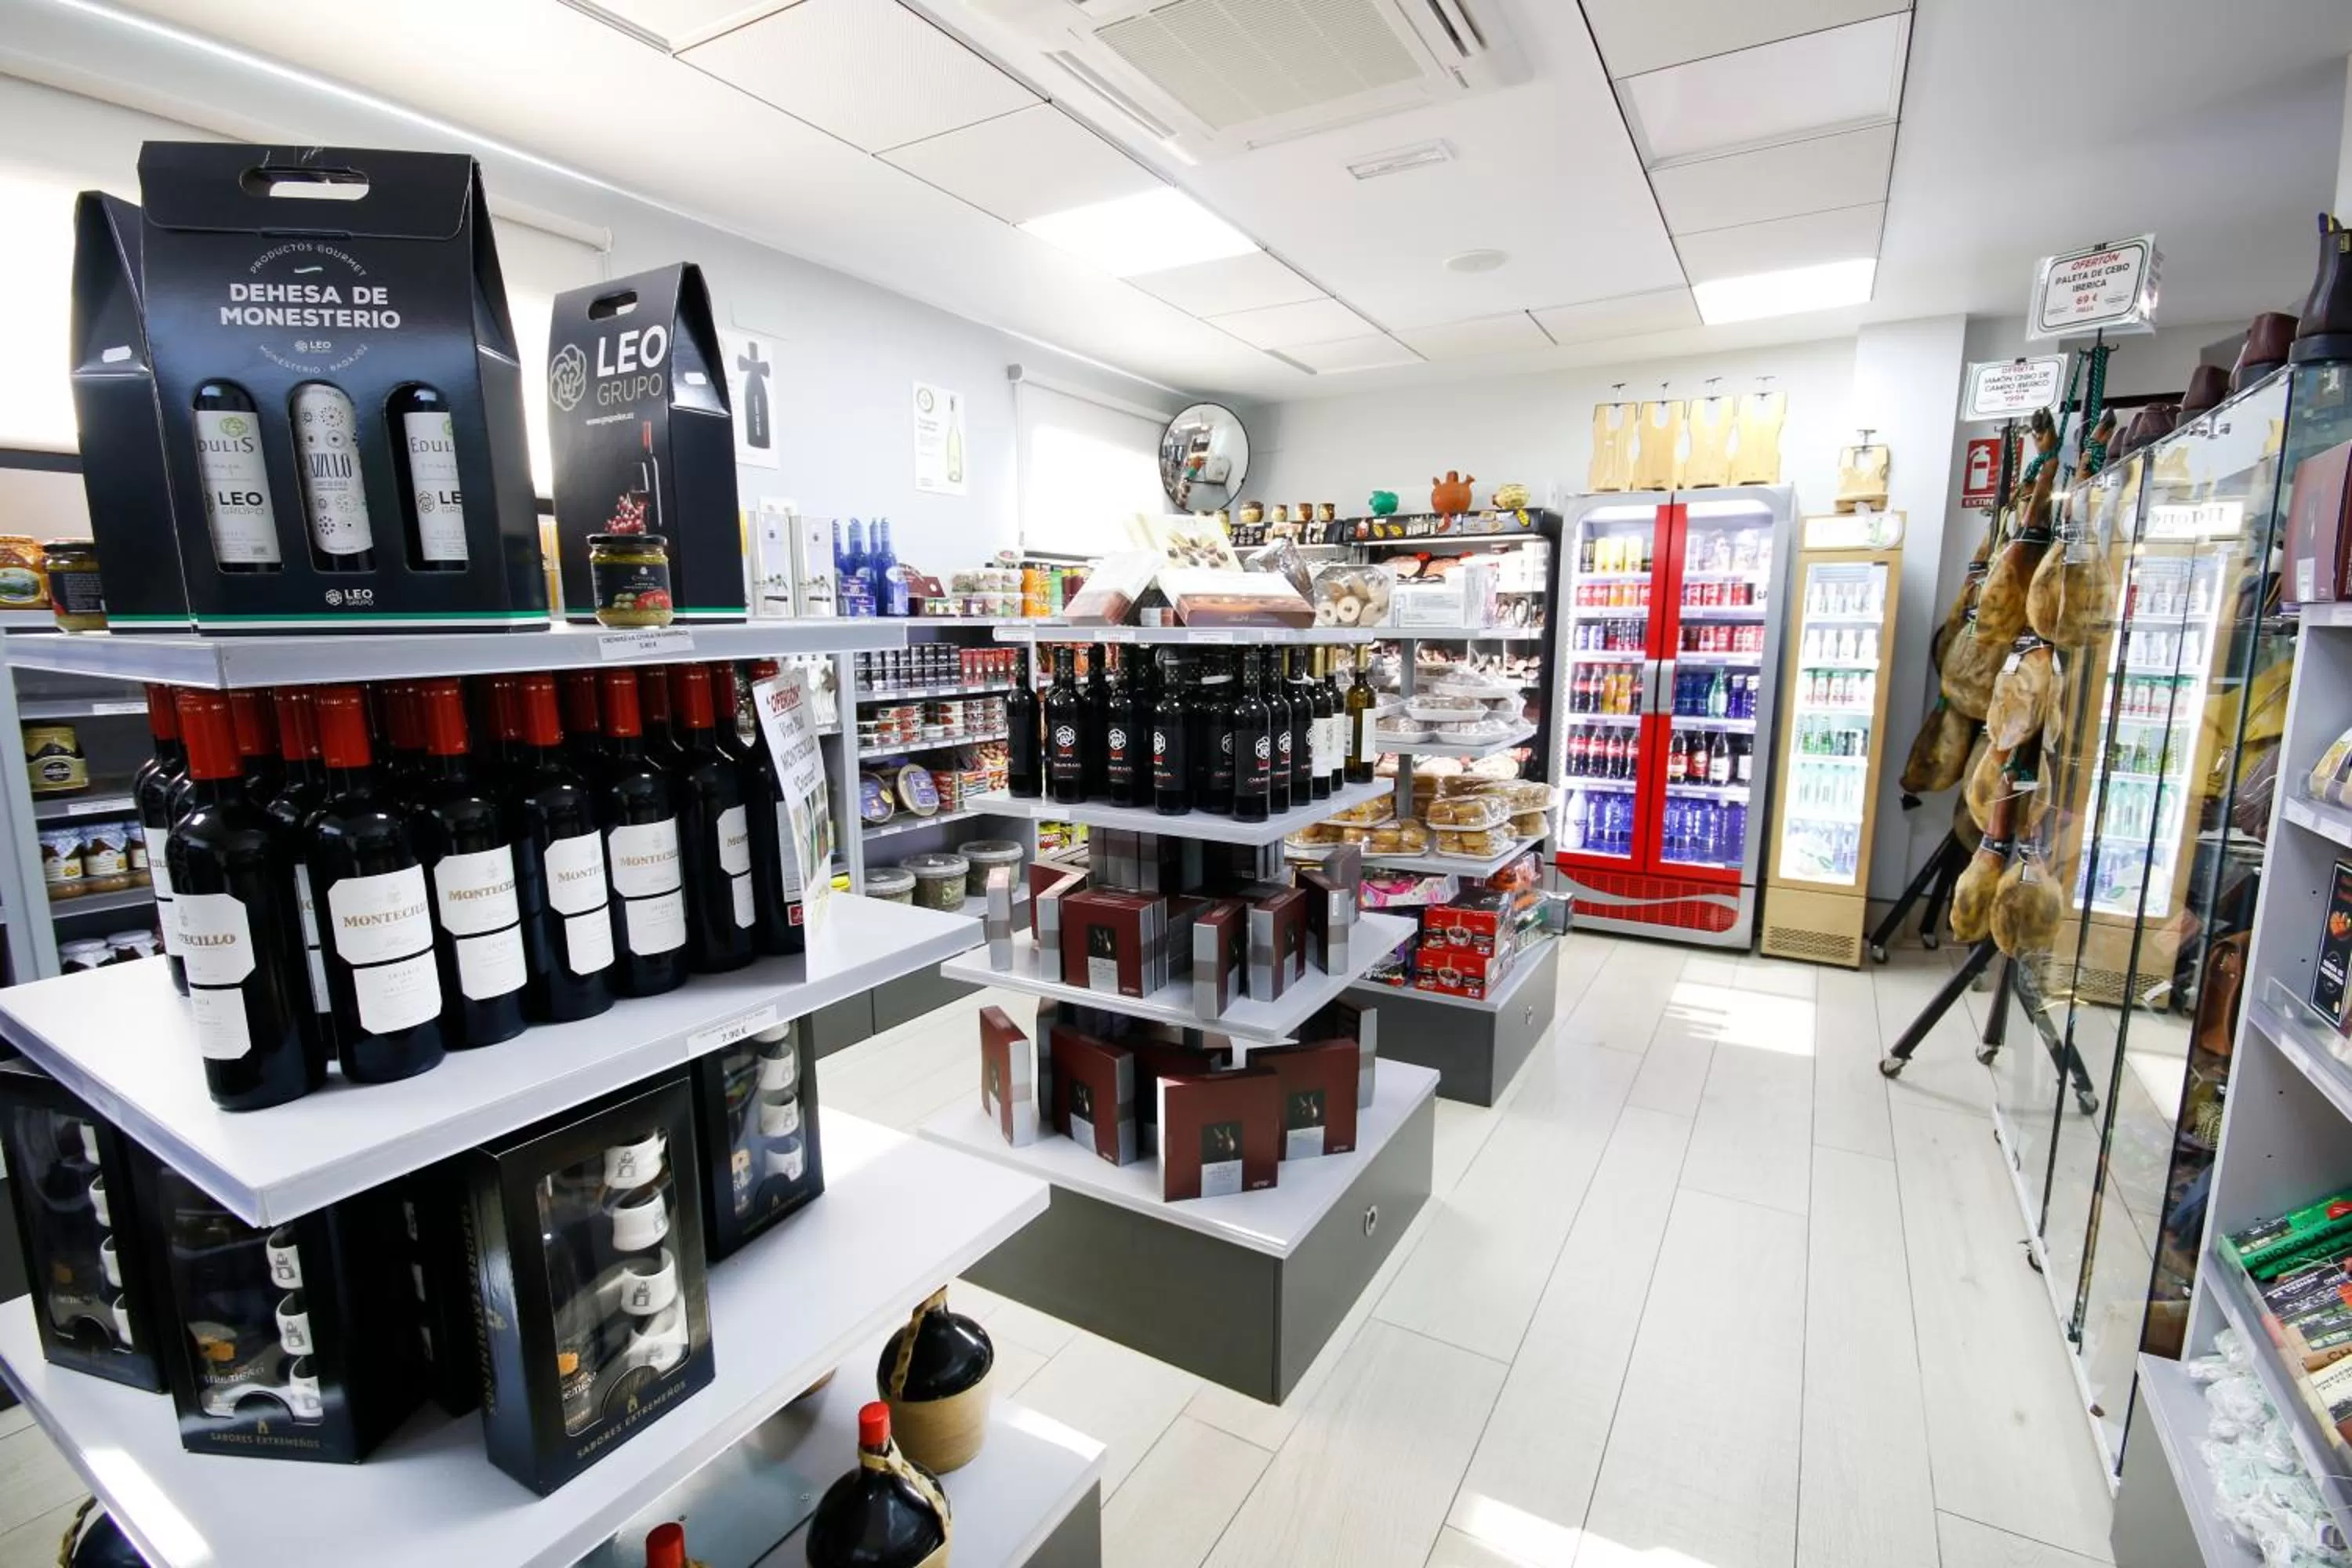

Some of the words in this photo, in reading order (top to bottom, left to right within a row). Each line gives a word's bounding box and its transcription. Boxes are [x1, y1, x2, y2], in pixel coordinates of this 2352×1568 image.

[250, 243, 313, 274] PRODUCTOS
[318, 244, 367, 276] GOURMET
[2056, 271, 2089, 285] PALETA
[2091, 268, 2103, 278] DE
[2105, 263, 2130, 275] CEBO
[230, 283, 343, 304] DEHESA
[352, 286, 388, 305] DE
[220, 307, 401, 328] MONESTERIO
[597, 325, 667, 378] LEO
[597, 373, 662, 406] GRUPO
[198, 437, 255, 453] DULIS
[409, 436, 454, 453] EDUL
[219, 491, 263, 506] LEO
[438, 490, 463, 505] LE
[1965, 498, 1995, 506] EXTIN
[221, 506, 264, 516] GRUPO
[344, 588, 373, 599] LEO
[576, 1423, 622, 1460] SABORES
